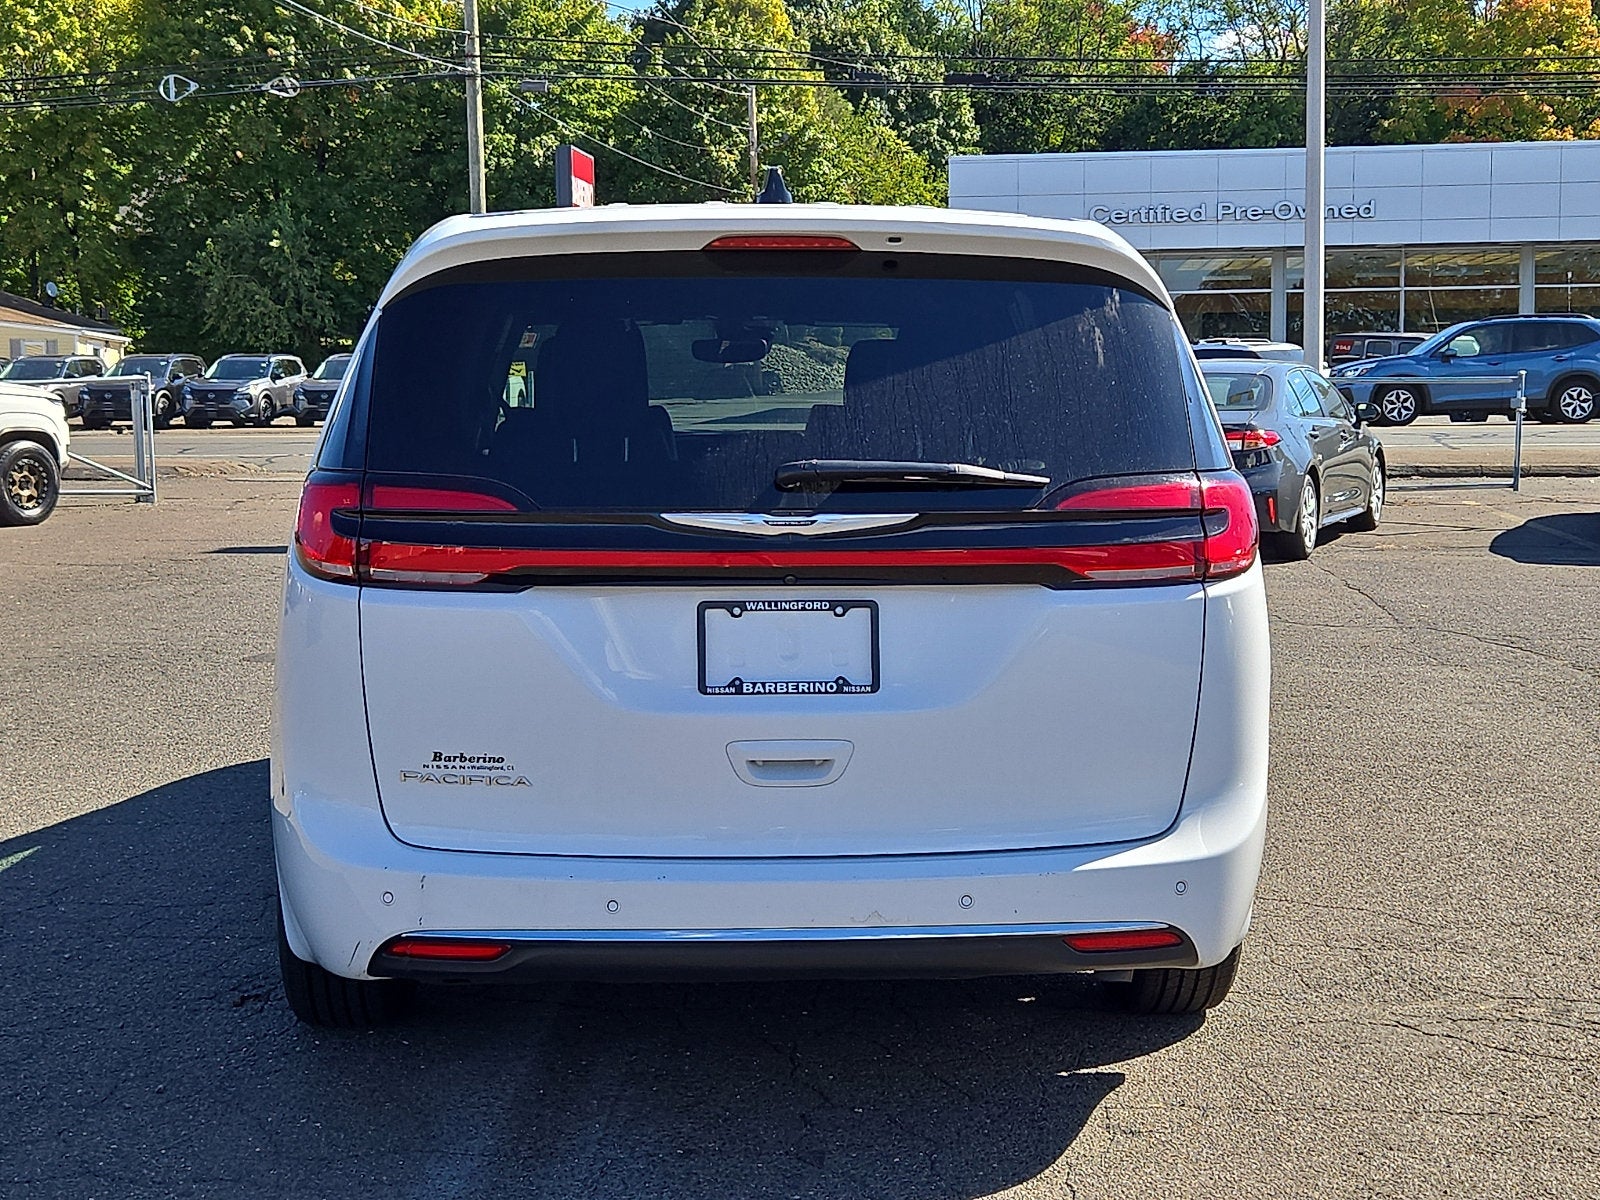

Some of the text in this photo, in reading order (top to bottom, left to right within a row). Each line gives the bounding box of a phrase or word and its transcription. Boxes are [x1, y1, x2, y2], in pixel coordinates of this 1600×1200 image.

[1089, 202, 1207, 225] Certified
[745, 601, 830, 611] WALLINGFORD
[706, 682, 872, 694] NISSAN BARBERINO NISSAN
[431, 751, 505, 764] Barberino
[422, 763, 466, 771] NISSAN
[399, 770, 533, 787] PACIFICA
